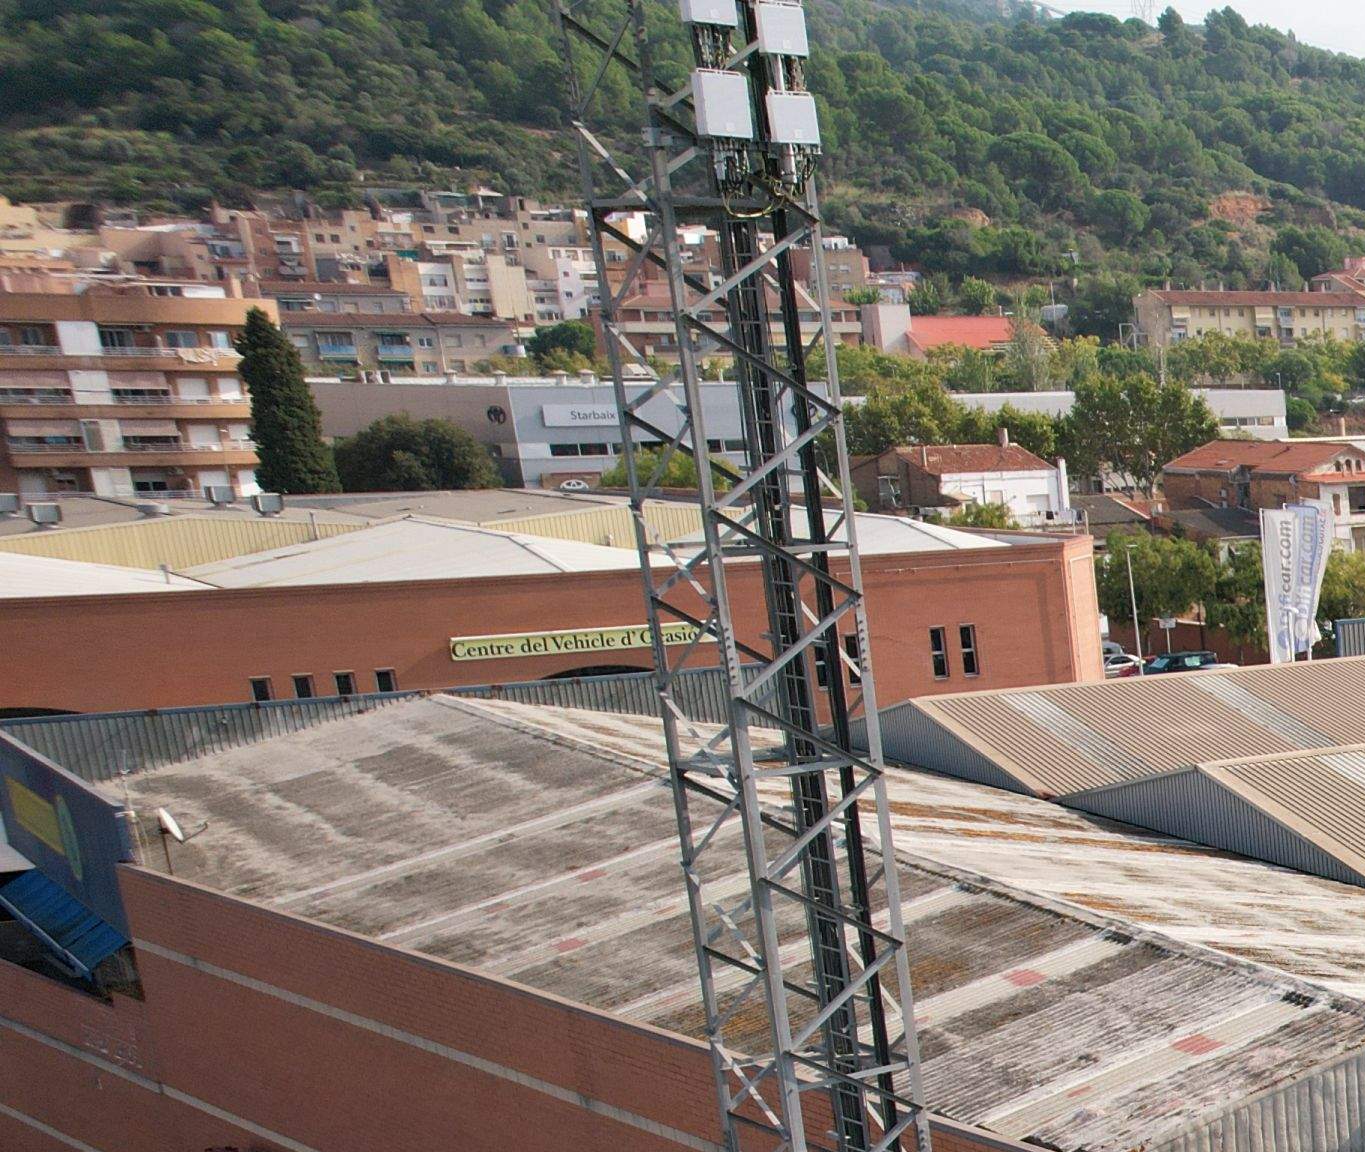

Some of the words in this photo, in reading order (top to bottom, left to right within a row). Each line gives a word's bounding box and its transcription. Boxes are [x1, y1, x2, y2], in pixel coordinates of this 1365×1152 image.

[570, 409, 616, 421] Starbaix
[451, 641, 515, 658] Centre
[520, 637, 548, 654] del
[552, 633, 616, 650] Vehicle
[639, 626, 697, 645] Oasió
